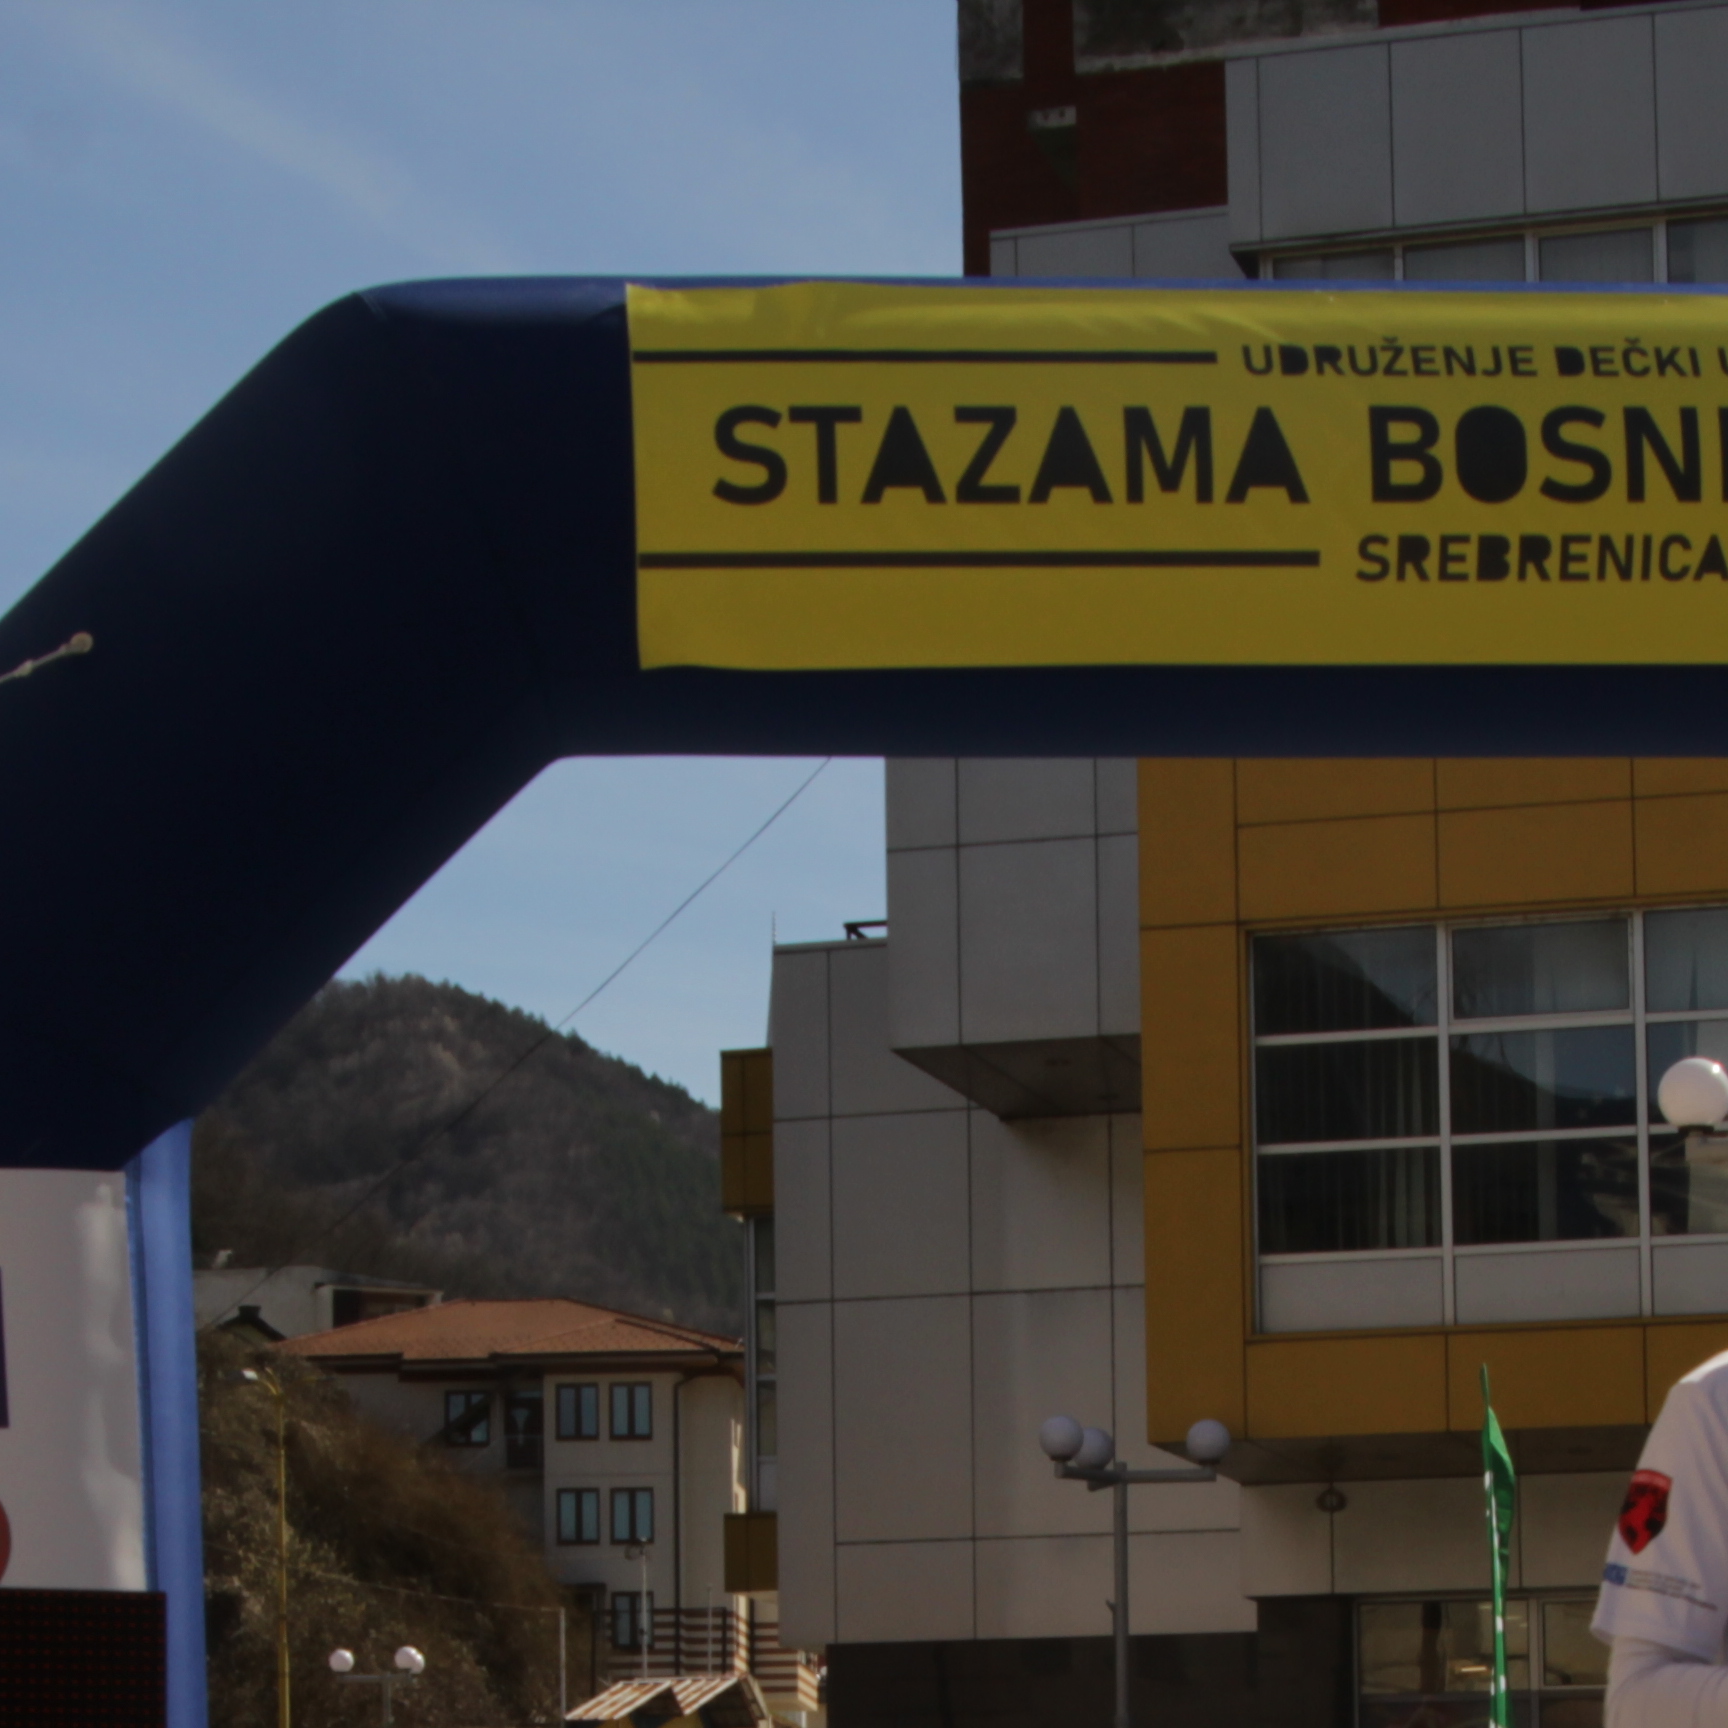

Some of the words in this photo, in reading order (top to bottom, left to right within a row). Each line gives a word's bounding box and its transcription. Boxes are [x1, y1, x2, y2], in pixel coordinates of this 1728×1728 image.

[1242, 338, 1538, 378] UDRUŽENJE
[1556, 338, 1702, 379] DEČKI
[711, 404, 1311, 506] STAZAMA
